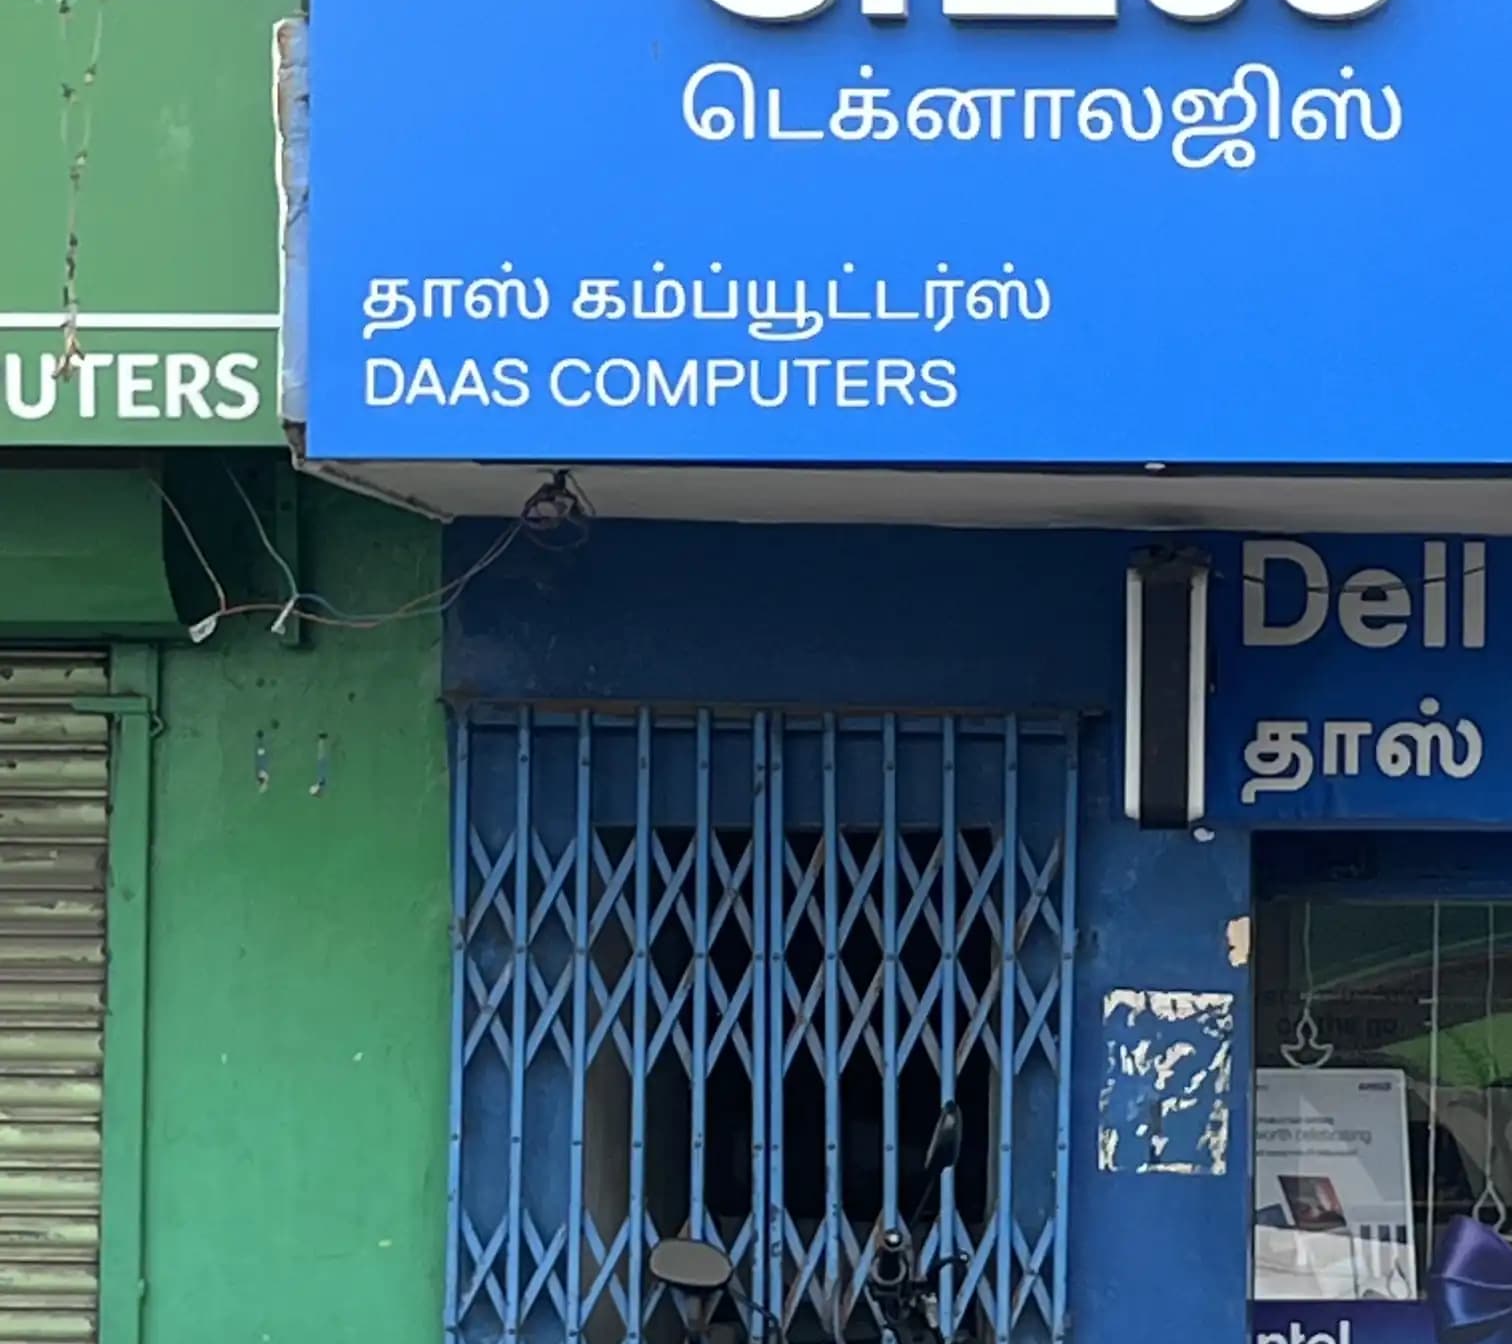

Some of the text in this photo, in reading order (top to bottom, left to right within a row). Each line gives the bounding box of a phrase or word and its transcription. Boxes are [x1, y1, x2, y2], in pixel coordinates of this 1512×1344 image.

[683, 62, 1402, 168] டெக்னாலஜிஸ்
[362, 261, 1051, 341] தாஸ் கம்ப்யூட்டர்ஸ்
[5, 353, 260, 420] UTERS
[366, 358, 957, 408] DAAS COMPUTERS
[1243, 541, 1486, 648] Dell
[1242, 698, 1483, 803] தாஸ்
